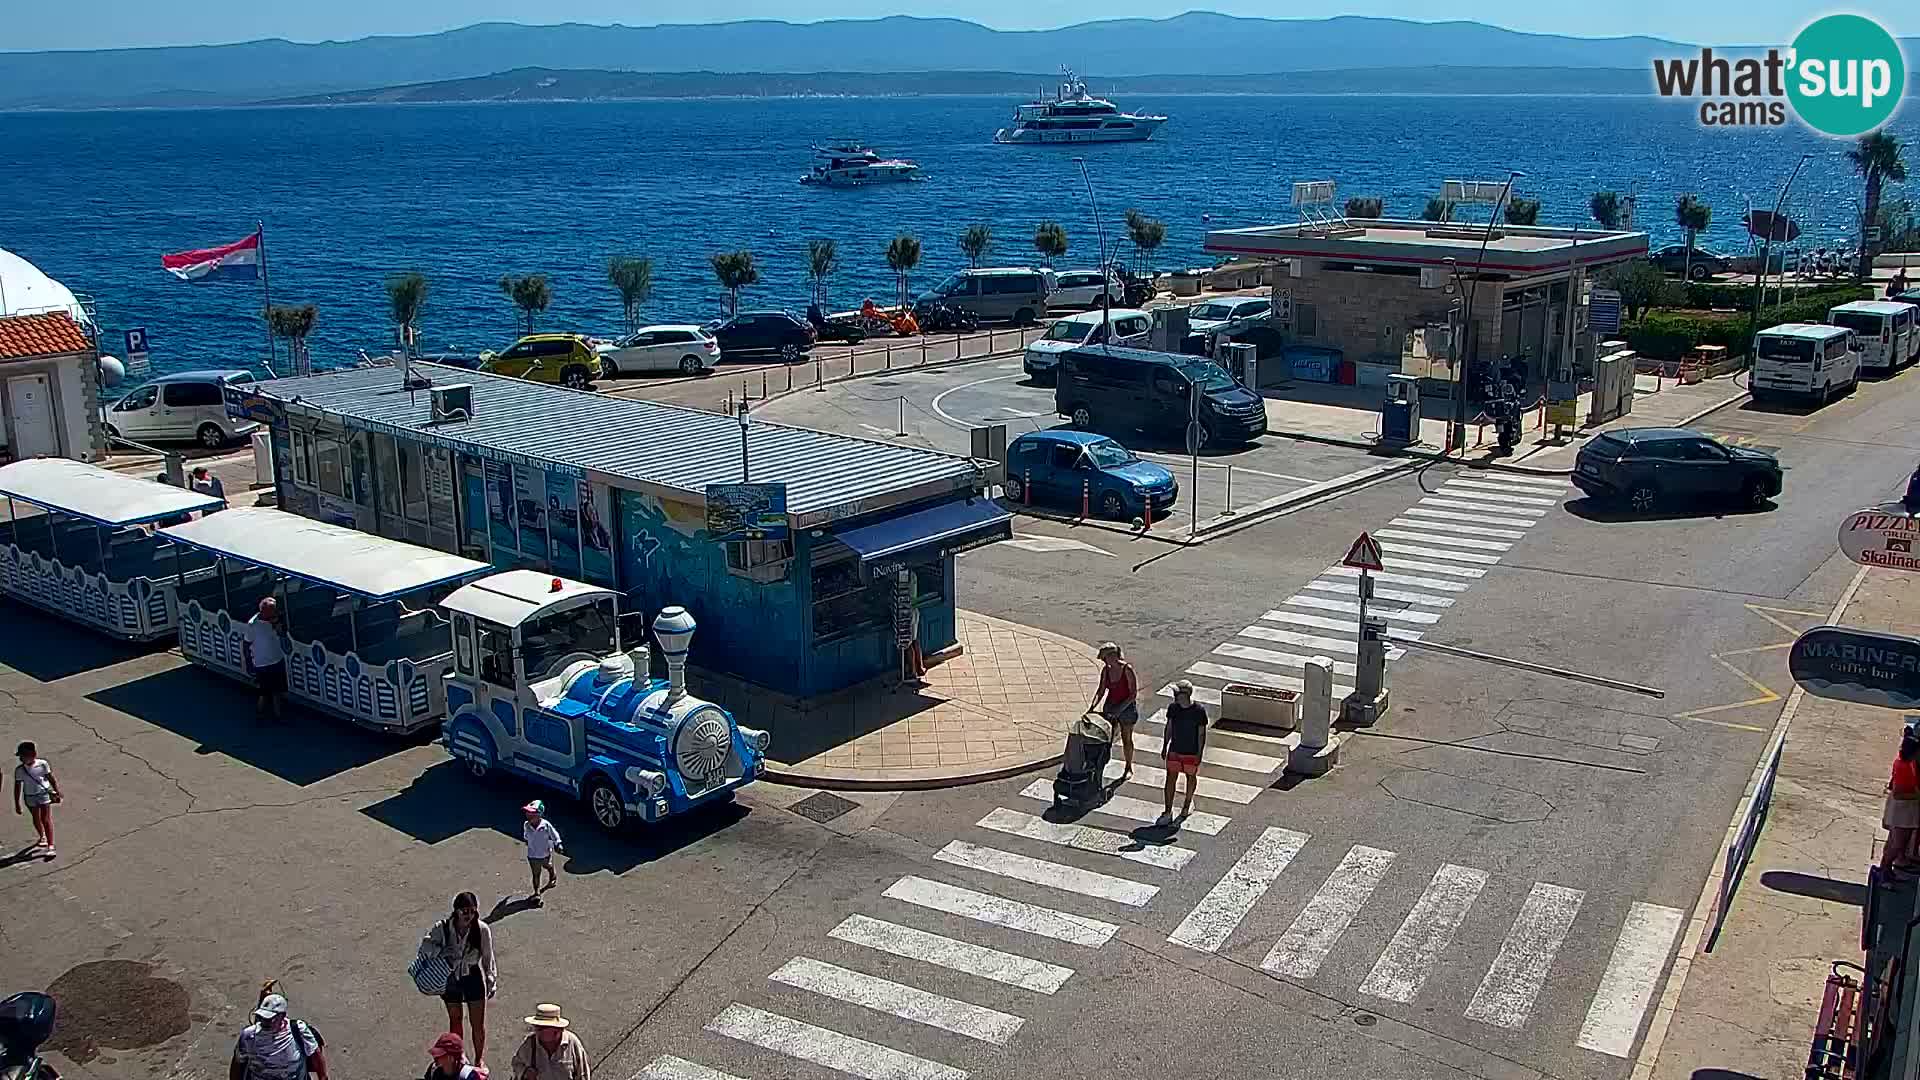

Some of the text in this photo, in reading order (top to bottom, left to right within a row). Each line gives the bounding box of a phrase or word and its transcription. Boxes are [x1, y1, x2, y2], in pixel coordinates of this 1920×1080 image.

[129, 332, 141, 350] P
[494, 449, 527, 465] STATION
[529, 458, 554, 471] TICKET
[555, 463, 582, 477] OFFICE
[1829, 661, 1898, 680] caffe bar
